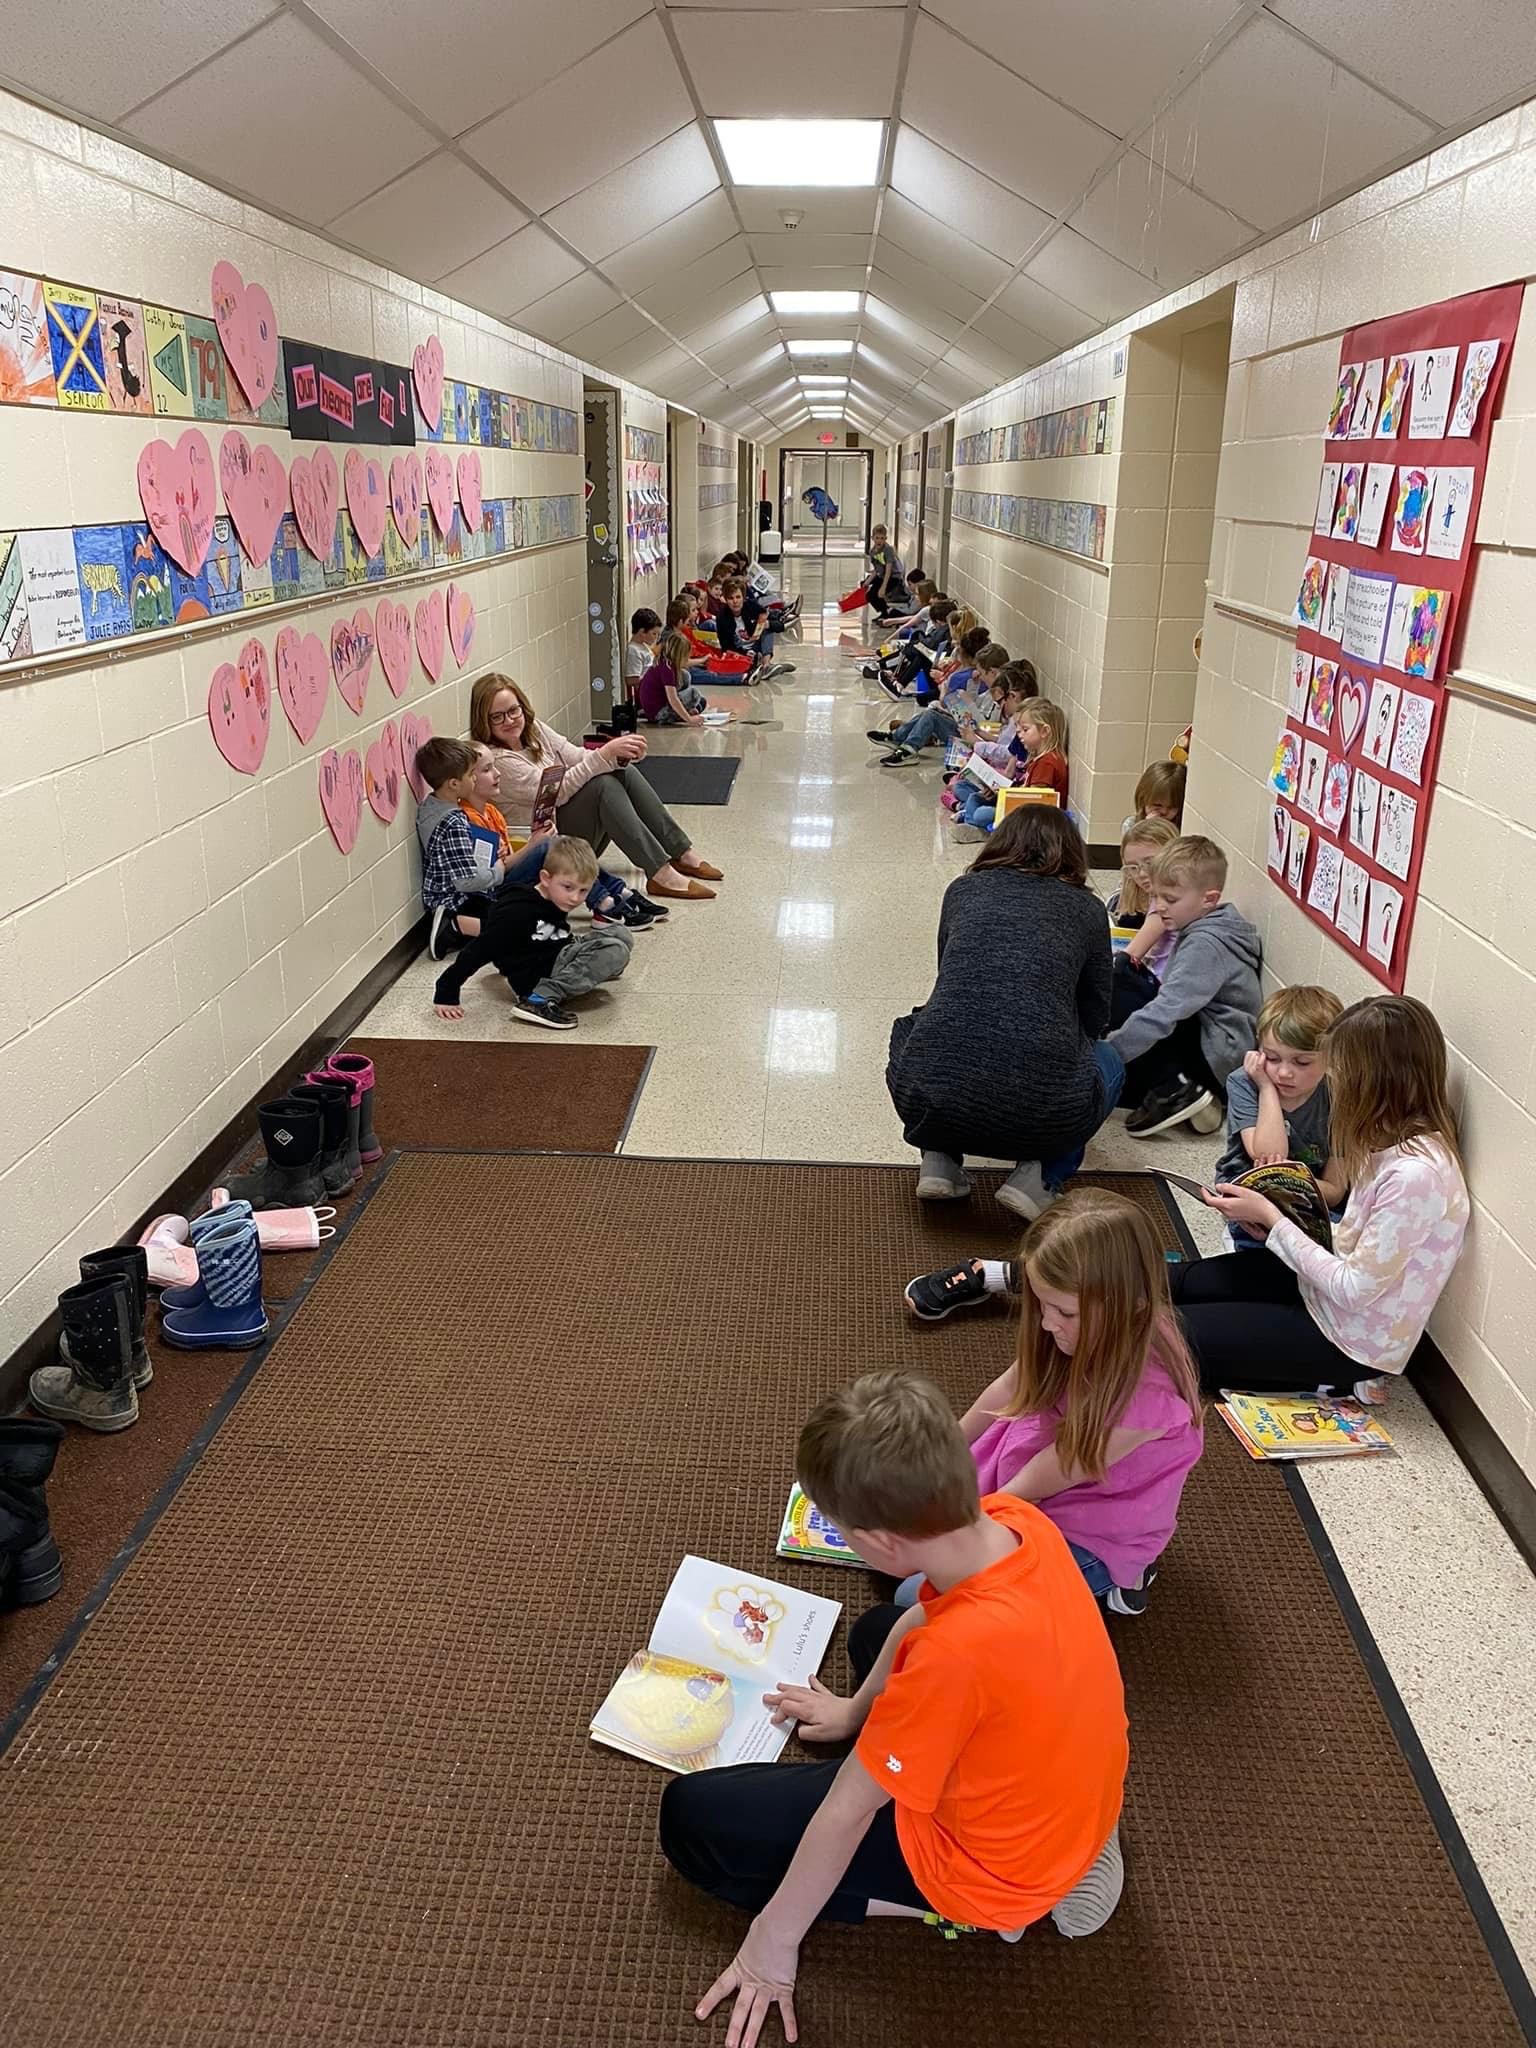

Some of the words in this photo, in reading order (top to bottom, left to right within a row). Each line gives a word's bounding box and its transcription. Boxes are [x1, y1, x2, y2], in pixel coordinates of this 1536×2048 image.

[64, 390, 105, 409] SENIOR
[157, 394, 169, 413] 12
[321, 378, 353, 423] hearts
[356, 378, 372, 401] are
[90, 624, 111, 640] JULIE
[793, 1633, 808, 1656] Lulu's
[803, 1610, 816, 1631] shoes
